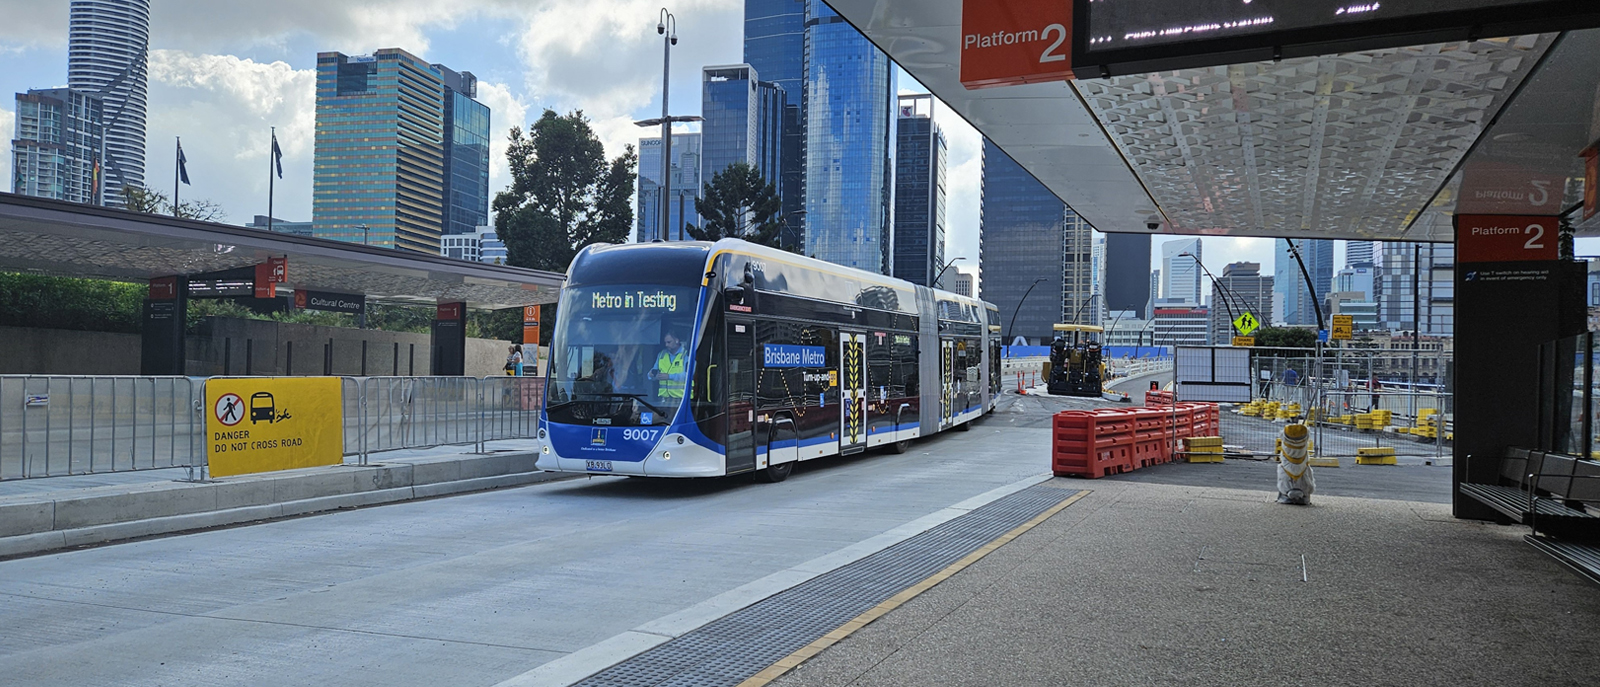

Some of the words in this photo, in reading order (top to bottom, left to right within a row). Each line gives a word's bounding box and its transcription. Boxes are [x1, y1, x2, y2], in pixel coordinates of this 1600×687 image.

[964, 30, 1038, 50] Platform
[1039, 23, 1067, 63] 2
[1472, 226, 1520, 236] Platform
[1524, 224, 1544, 249] 2
[168, 282, 172, 294] 1
[311, 297, 337, 307] Cultural
[338, 300, 360, 309] Centre
[592, 292, 622, 308] Metro
[625, 292, 634, 308] in
[637, 291, 676, 311] Testing
[453, 307, 457, 316] 1
[765, 347, 800, 364] Brisbane
[802, 348, 825, 364] Metro
[215, 430, 250, 440] DANGER
[623, 429, 658, 441] 9007
[215, 444, 227, 453] DO
[231, 442, 247, 452] NOT
[251, 440, 277, 450] CROSS
[282, 438, 302, 447] ROAD
